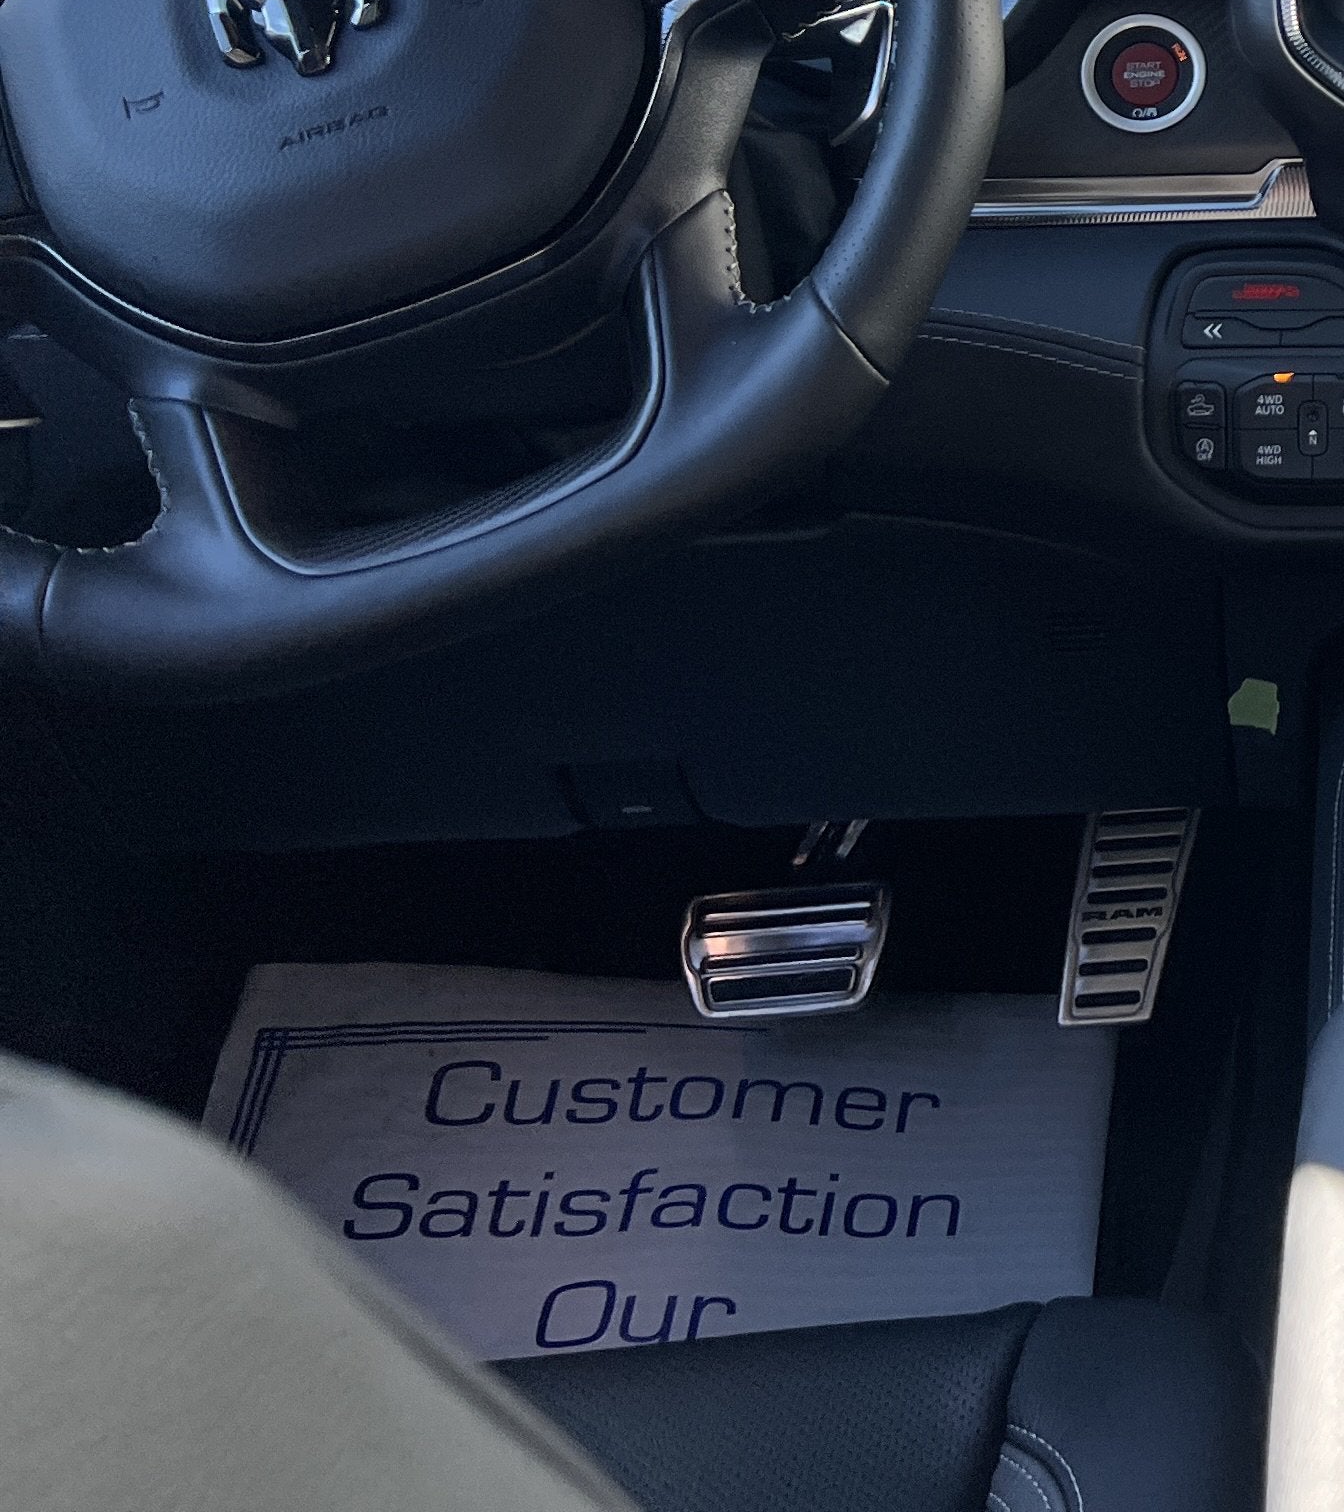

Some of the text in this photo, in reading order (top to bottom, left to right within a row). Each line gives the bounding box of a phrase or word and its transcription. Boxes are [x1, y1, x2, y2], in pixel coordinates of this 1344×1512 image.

[1126, 61, 1162, 69] START
[1124, 70, 1165, 79] ENGINE
[1129, 79, 1161, 88] STOP
[1256, 394, 1283, 405] 4WD
[1255, 404, 1285, 416] AUTO
[1257, 445, 1282, 455] 4WD
[1256, 455, 1283, 465] HIGH
[1082, 907, 1163, 923] RAM
[425, 1059, 942, 1134] Customer
[343, 1167, 962, 1241] Satisfaction
[535, 1279, 738, 1350] Our
